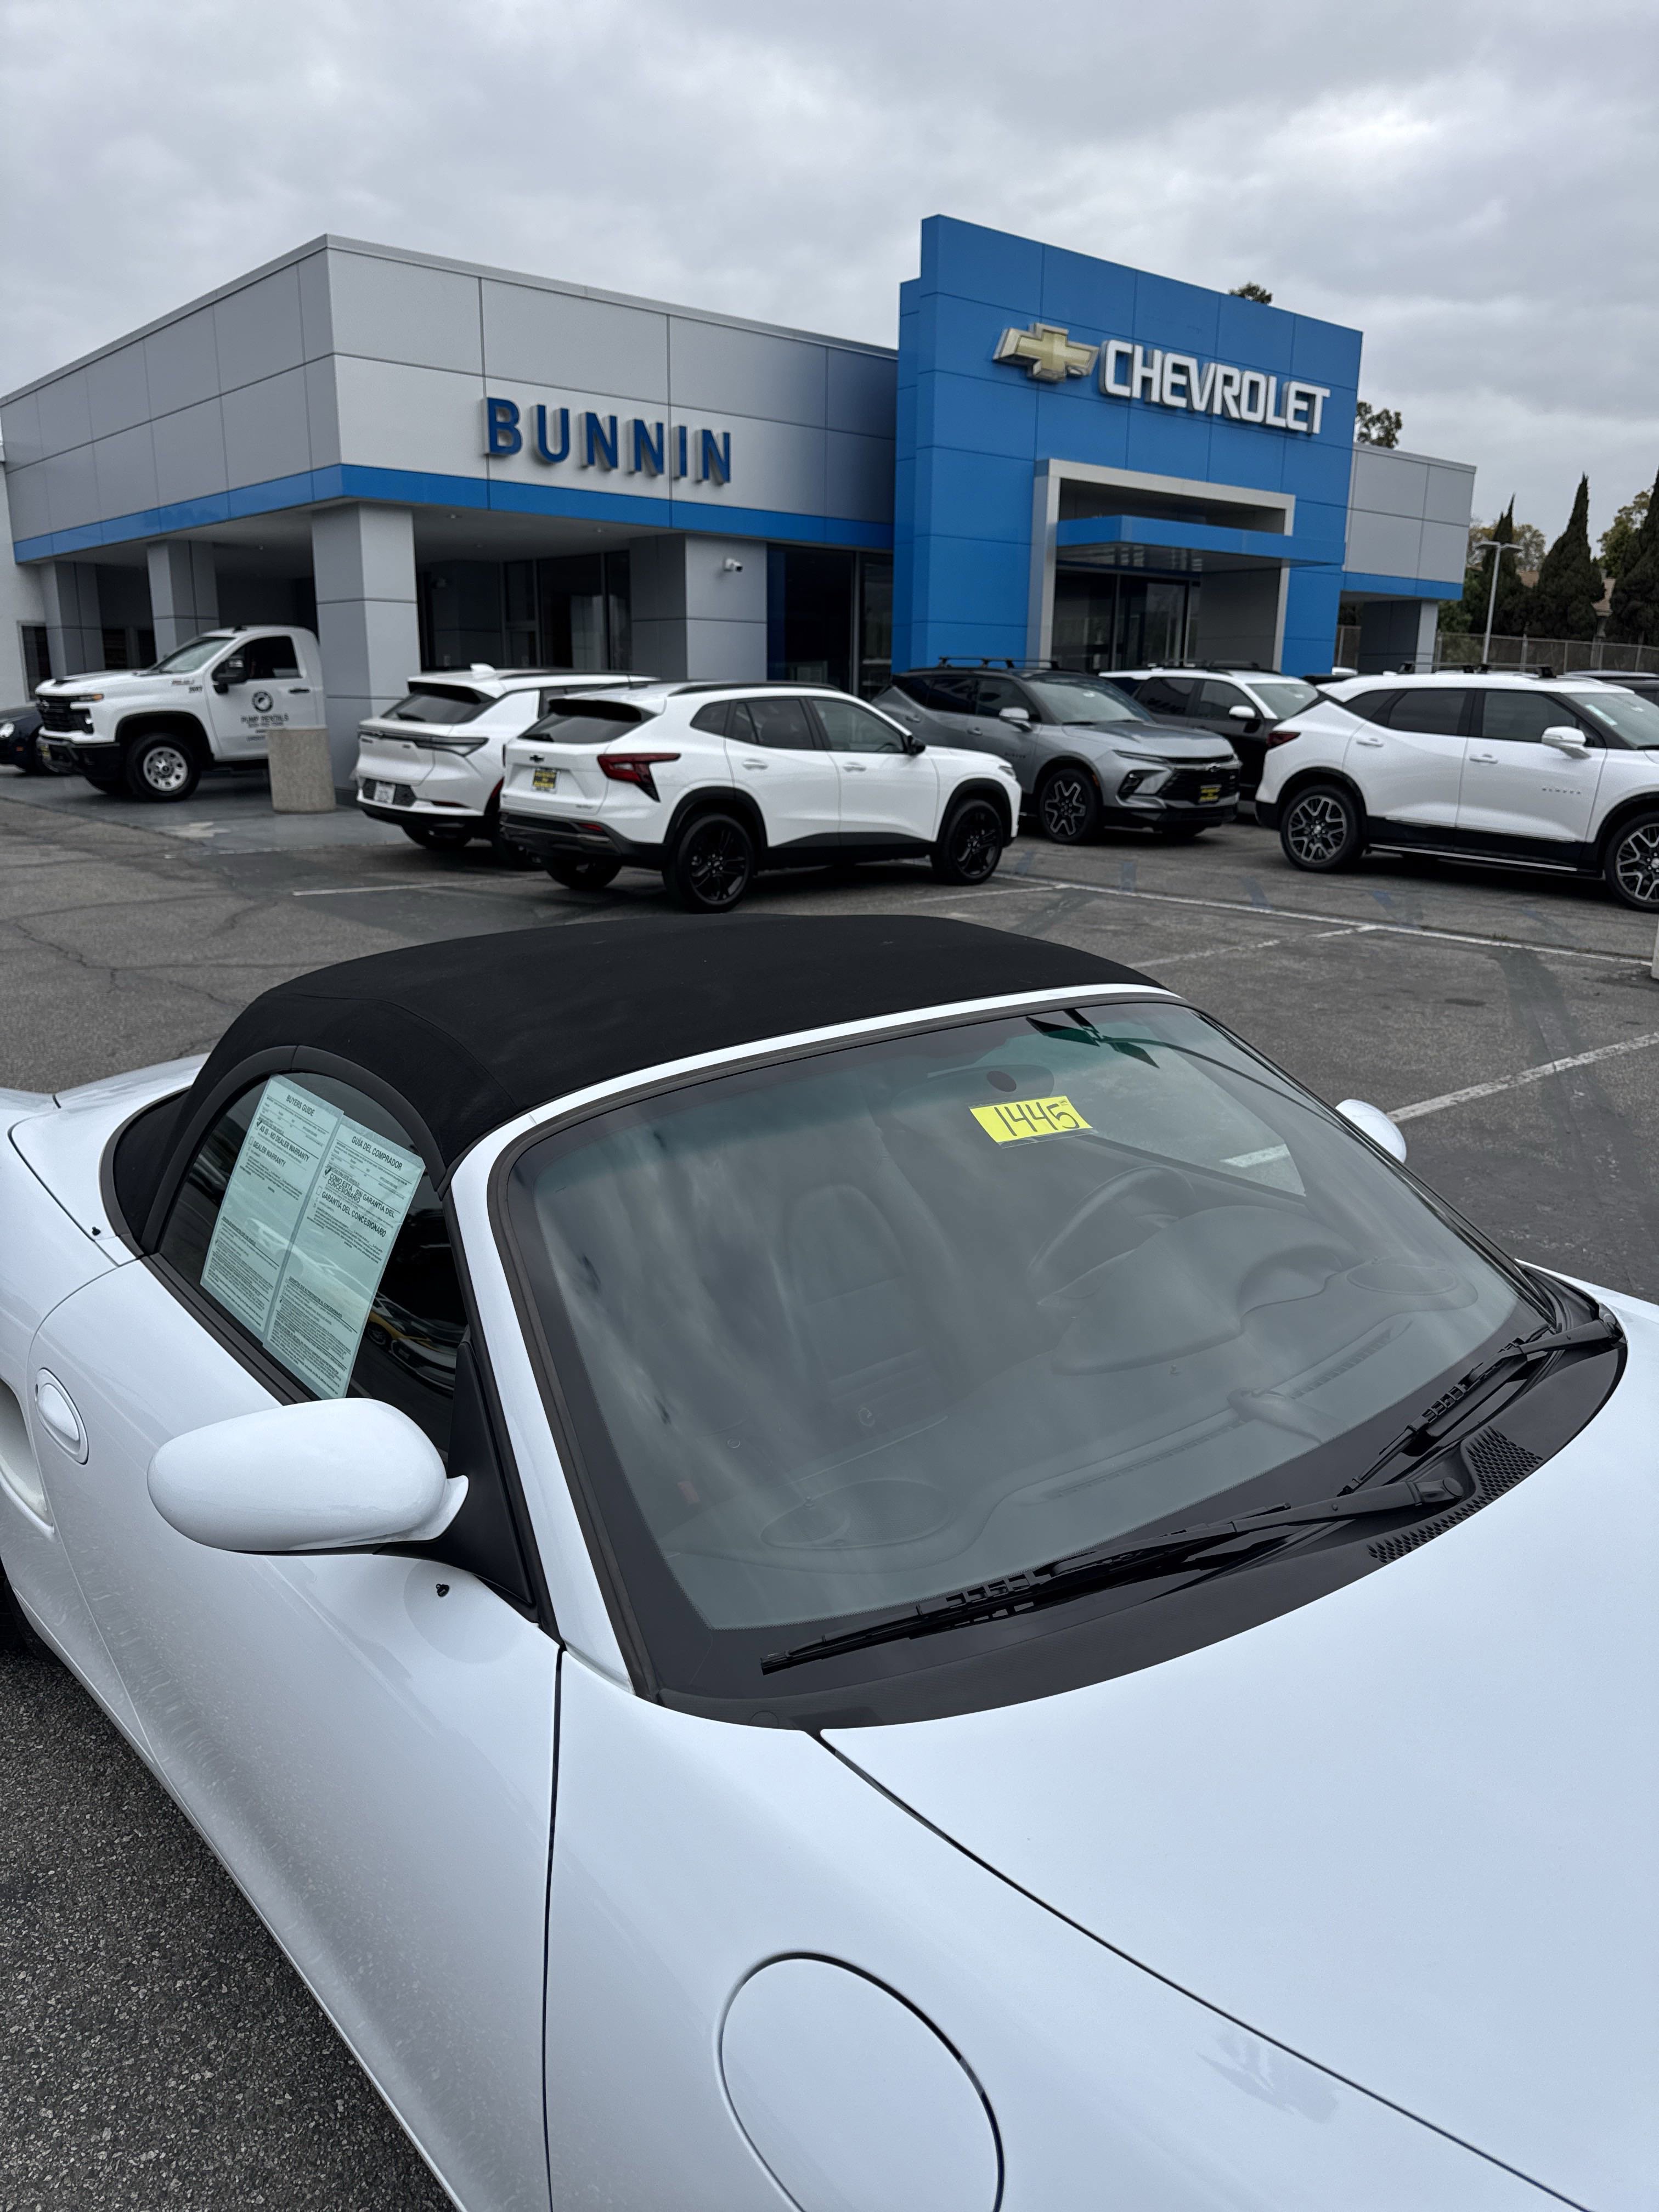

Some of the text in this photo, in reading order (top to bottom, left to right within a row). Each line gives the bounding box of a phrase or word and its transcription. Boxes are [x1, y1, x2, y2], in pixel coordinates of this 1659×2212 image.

[1101, 339, 1331, 435] CHEVROLET
[485, 397, 731, 484] BUNNIN
[286, 1094, 315, 1116] BUYERS GUIDE
[994, 1102, 1080, 1137] 1445
[253, 1141, 267, 1155] DEALER
[266, 1150, 286, 1167] WARRANTY
[259, 1125, 266, 1133] AS
[269, 1132, 276, 1140] NO
[275, 1135, 290, 1149] DEALER
[289, 1144, 310, 1162] WARRANTY
[362, 1143, 372, 1153] DEL
[371, 1148, 403, 1171] COMPRADOR
[328, 1178, 360, 1204] CONCESIONARIO
[330, 1173, 342, 1184] COMO
[355, 1189, 363, 1198] SIN
[385, 1207, 394, 1218] DEL
[342, 1204, 351, 1216] DEL
[351, 1210, 387, 1238] CONCESIONARIO
